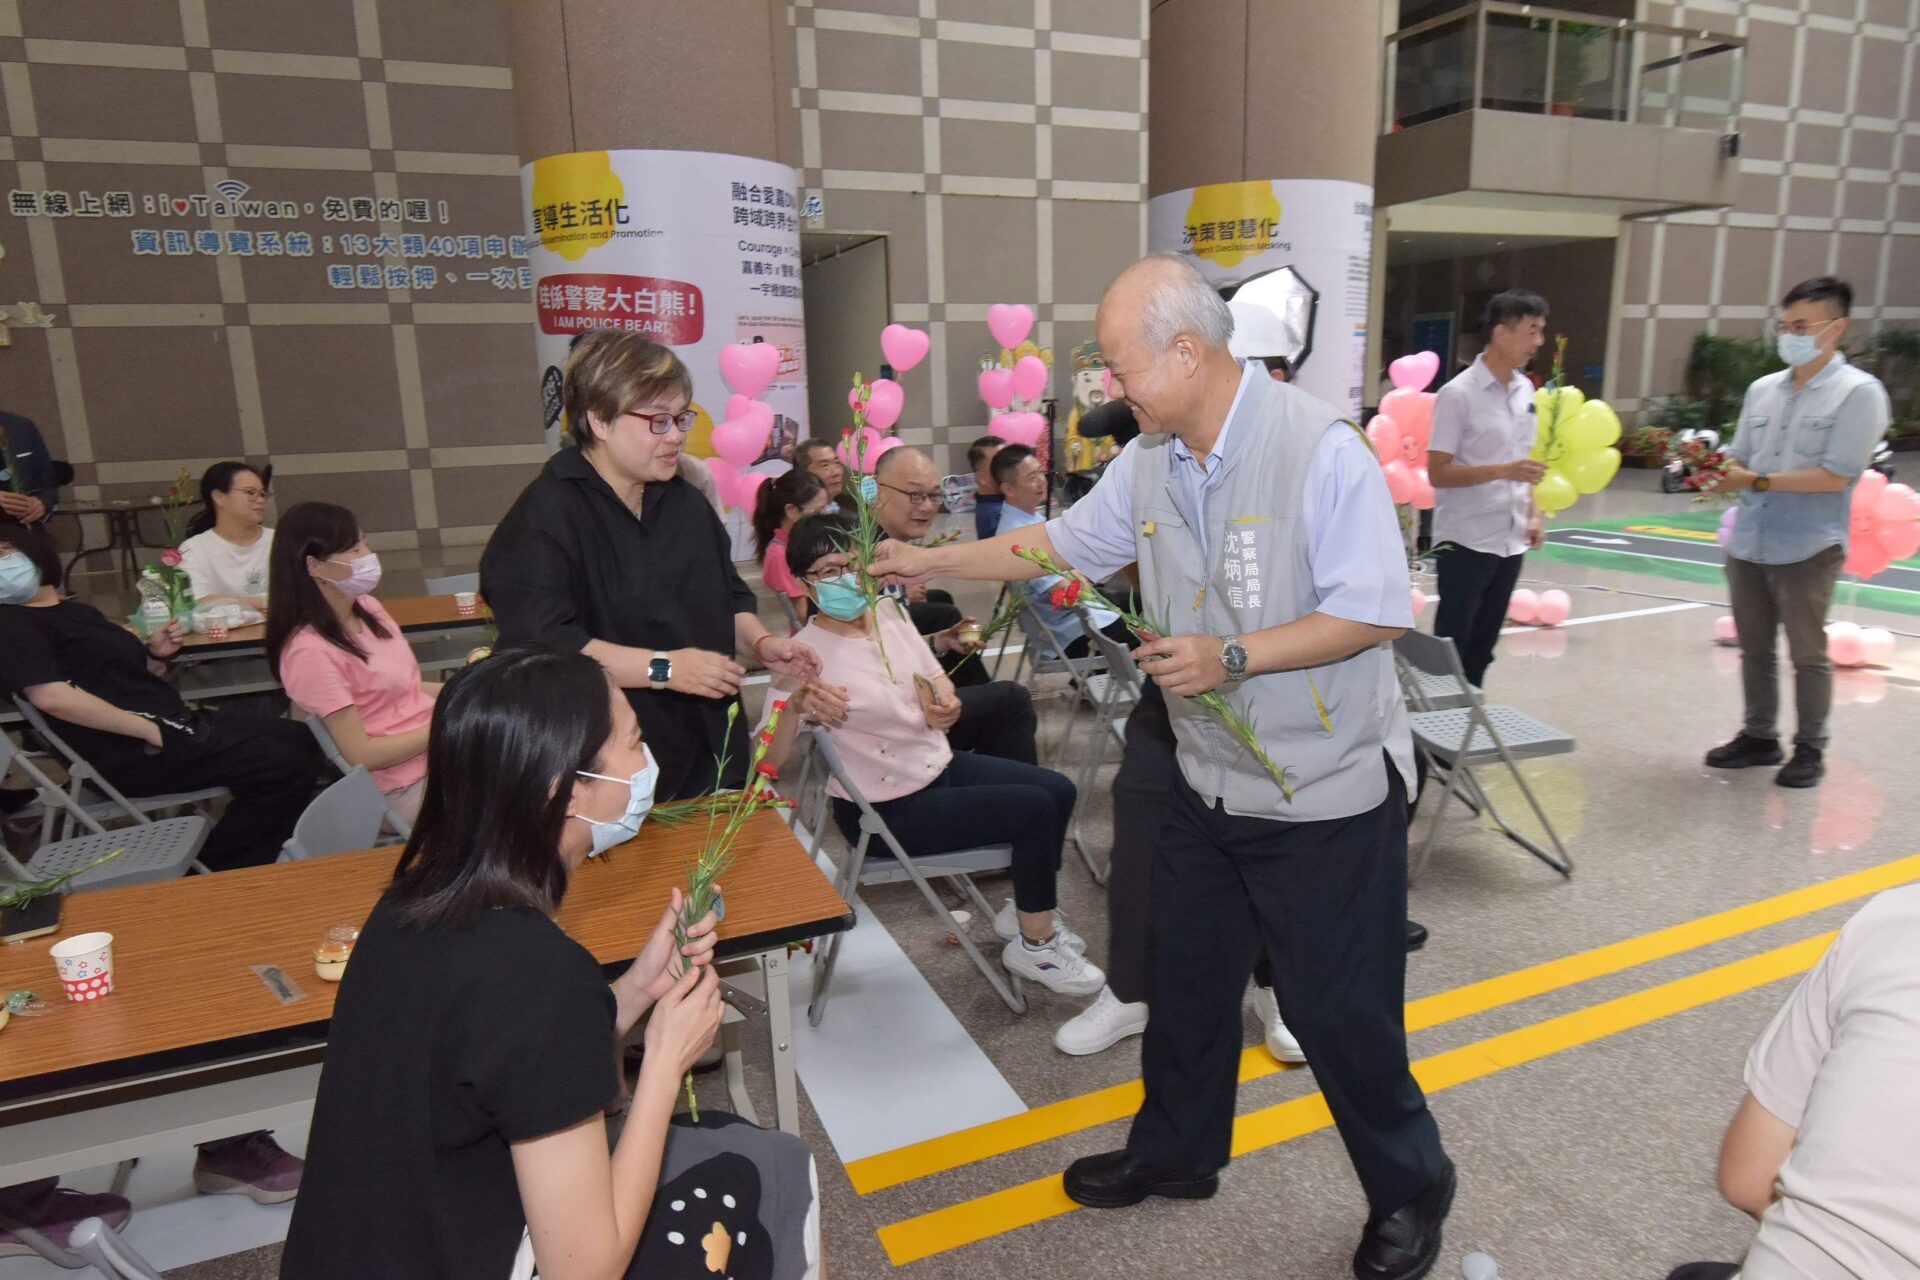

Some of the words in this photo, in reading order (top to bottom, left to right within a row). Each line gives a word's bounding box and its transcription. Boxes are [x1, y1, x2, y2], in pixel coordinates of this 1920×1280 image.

[610, 228, 664, 239] Promotion
[737, 239, 783, 258] Courage
[558, 316, 575, 329] AM
[576, 317, 622, 331] POLICE
[1224, 531, 1244, 608] 沈炳信
[1240, 531, 1261, 608] 警察局局長
